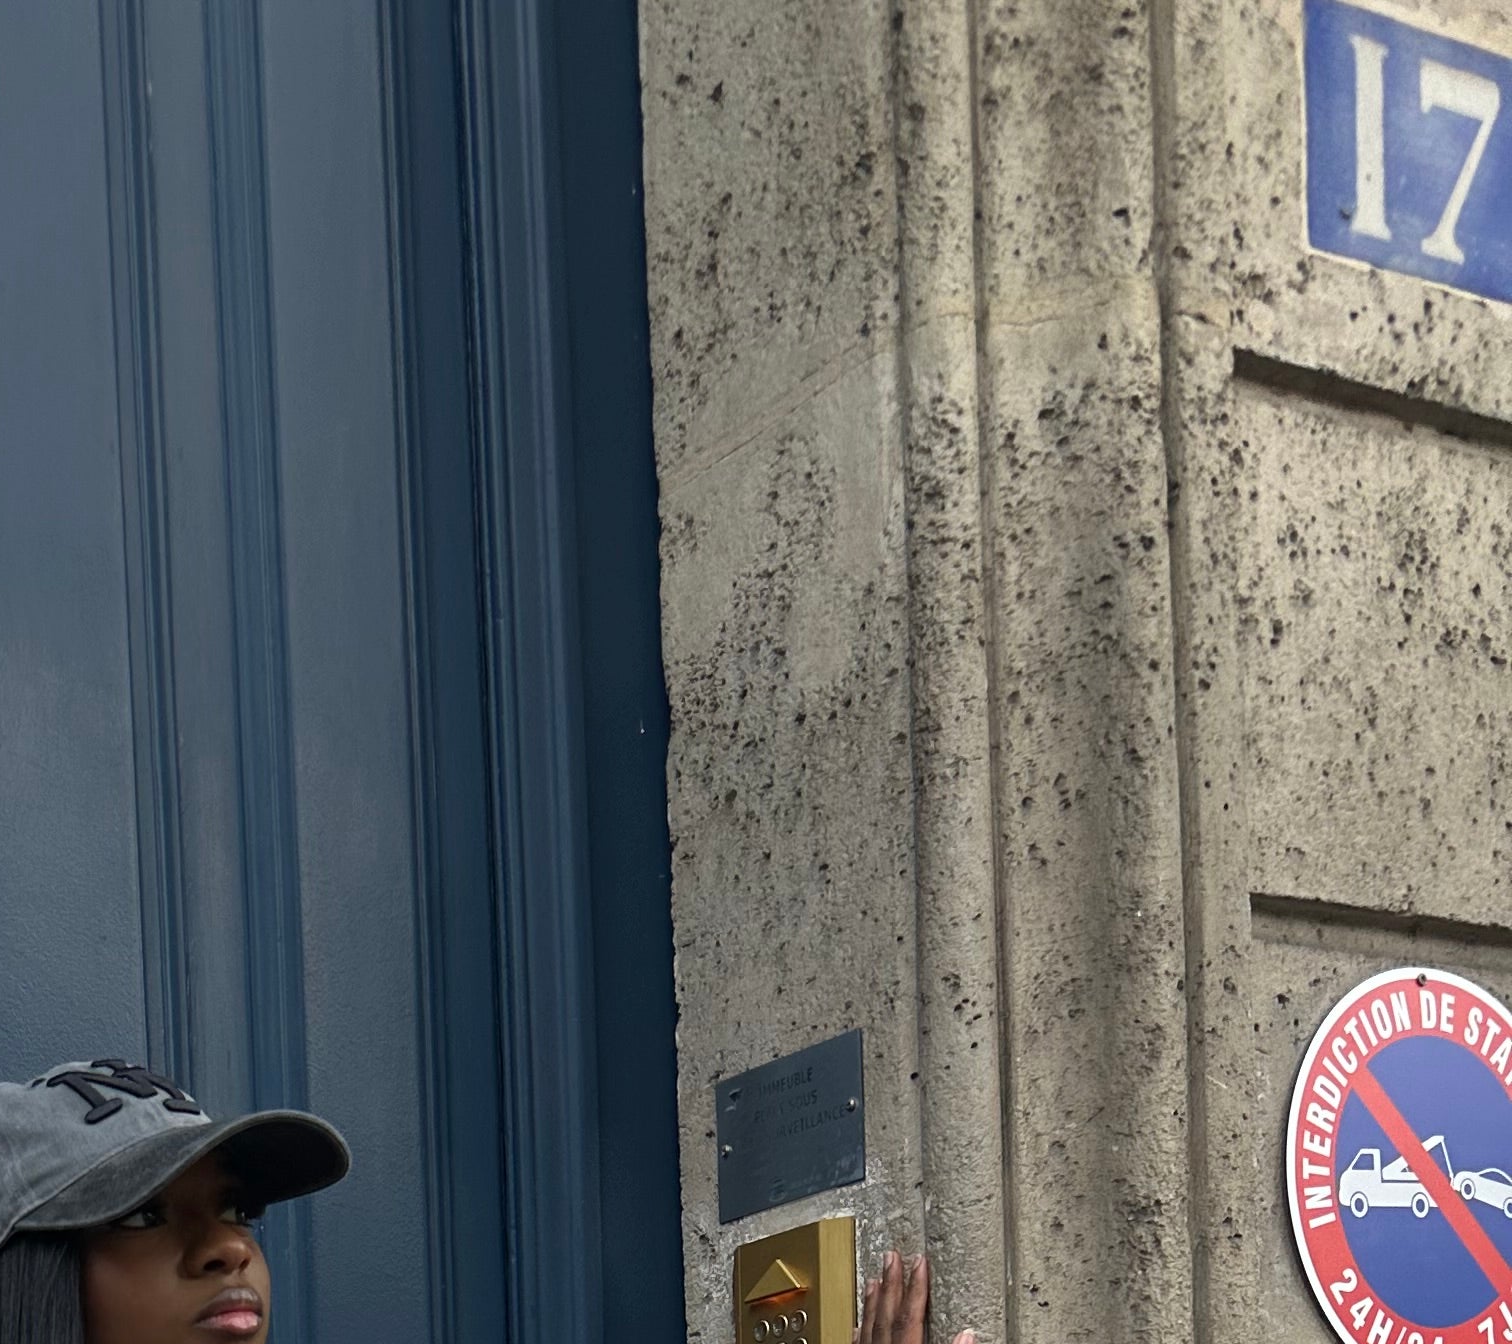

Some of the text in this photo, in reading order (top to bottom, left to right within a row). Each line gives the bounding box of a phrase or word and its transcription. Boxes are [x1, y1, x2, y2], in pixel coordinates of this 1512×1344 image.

[1348, 33, 1501, 265] 17
[1302, 989, 1512, 1229] INTERDICTION DE STA
